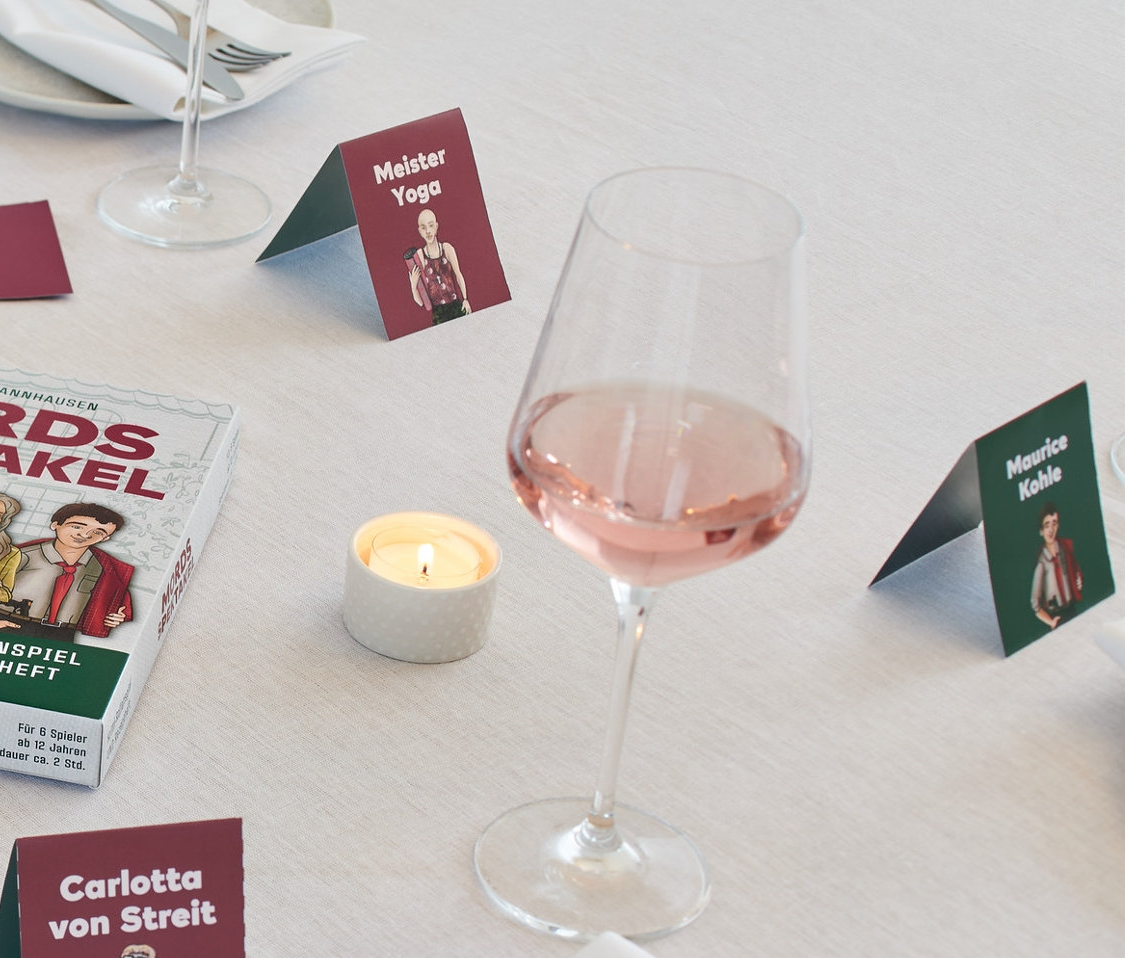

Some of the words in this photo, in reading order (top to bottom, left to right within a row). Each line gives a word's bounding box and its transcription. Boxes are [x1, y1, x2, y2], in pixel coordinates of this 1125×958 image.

[373, 149, 445, 184] Meister
[391, 180, 442, 206] Yoga
[1006, 435, 1068, 480] Maurice
[1018, 465, 1062, 501] Kohle
[162, 538, 191, 614] MORDS
[17, 738, 30, 748] ab
[35, 740, 45, 750] 12
[49, 744, 86, 757] Jahren
[18, 723, 35, 734] Für
[39, 727, 46, 736] 6
[50, 729, 87, 743] Spieler
[33, 755, 49, 765] ca.
[53, 757, 59, 766] 2
[64, 759, 85, 770] Std.
[59, 867, 202, 902] Carlotta
[48, 915, 110, 940] von
[120, 899, 217, 933] Streit
